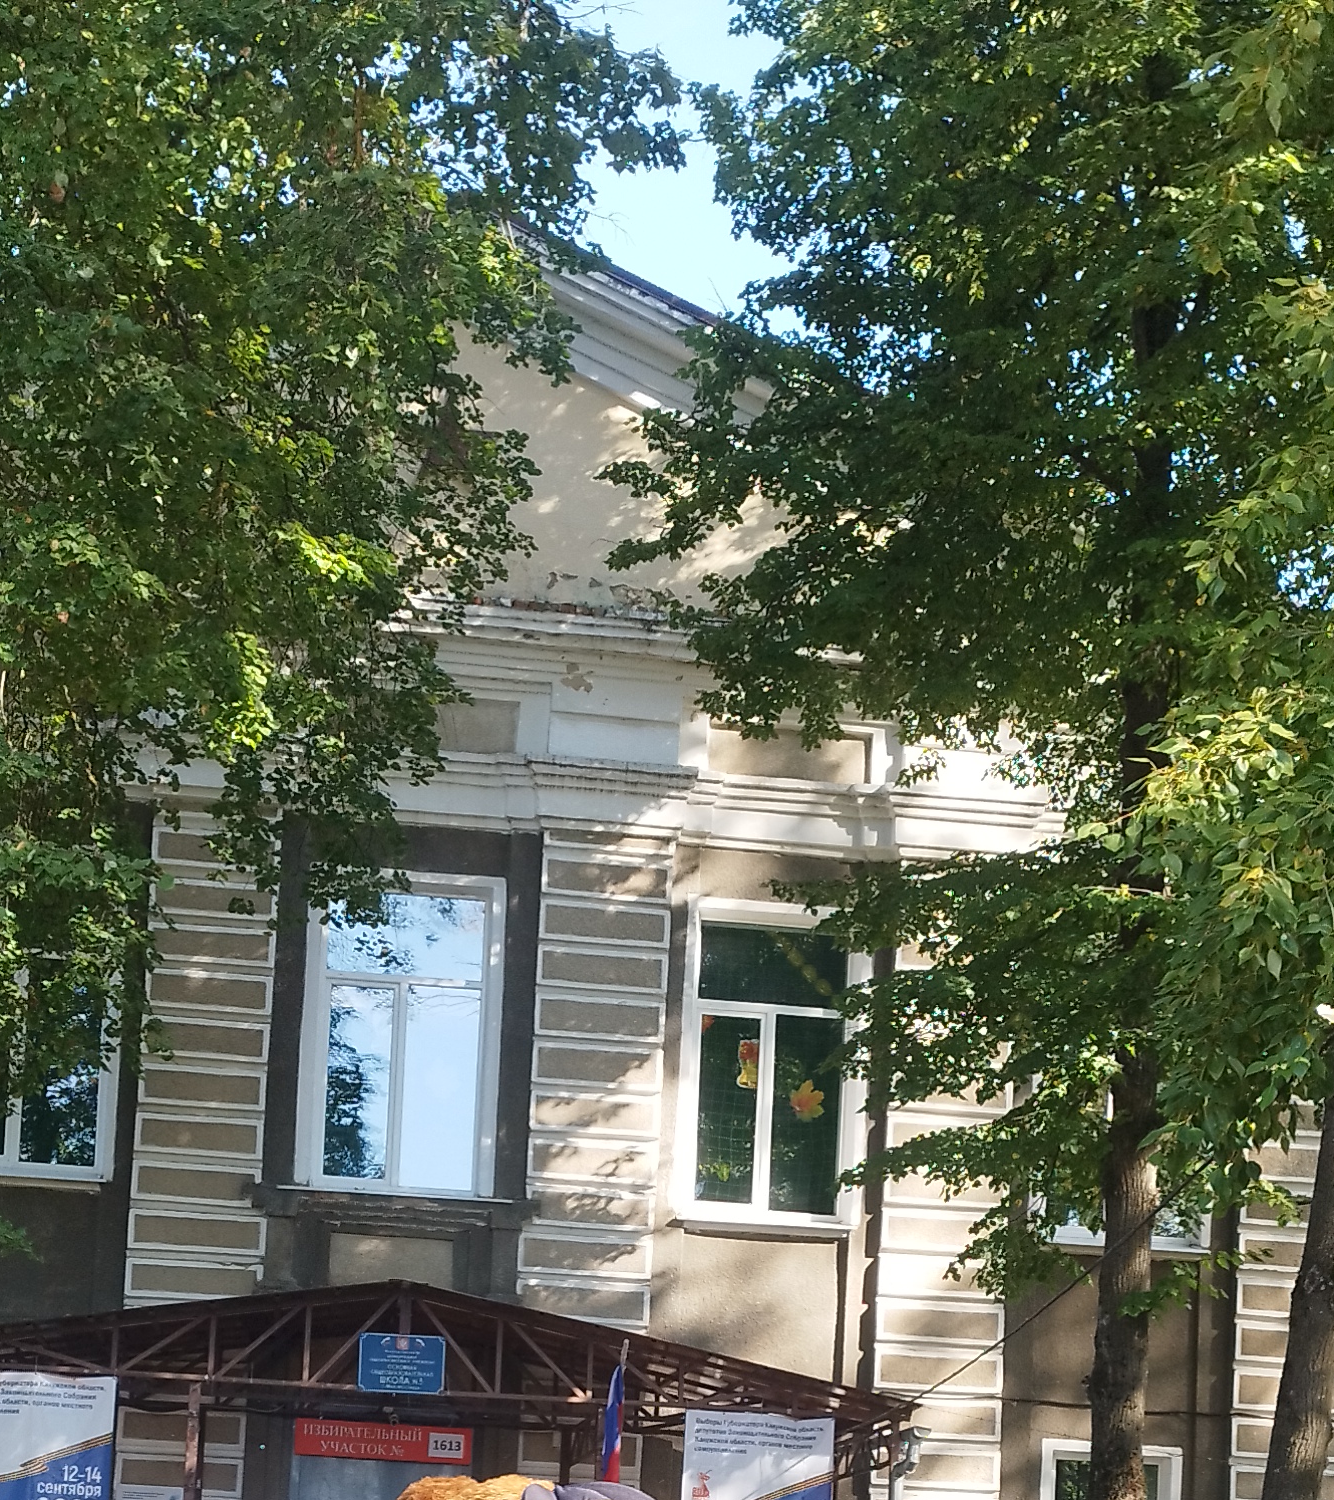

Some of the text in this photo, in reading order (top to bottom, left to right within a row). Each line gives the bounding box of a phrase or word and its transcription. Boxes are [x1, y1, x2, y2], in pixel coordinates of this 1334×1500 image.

[303, 1423, 422, 1442] ИЗБИРАТЕЛЬНЫЙ
[320, 1440, 404, 1457] УЧАСТОК №
[432, 1439, 462, 1452] 1613
[62, 1465, 102, 1483] 12-14
[36, 1482, 102, 1498] сентября
